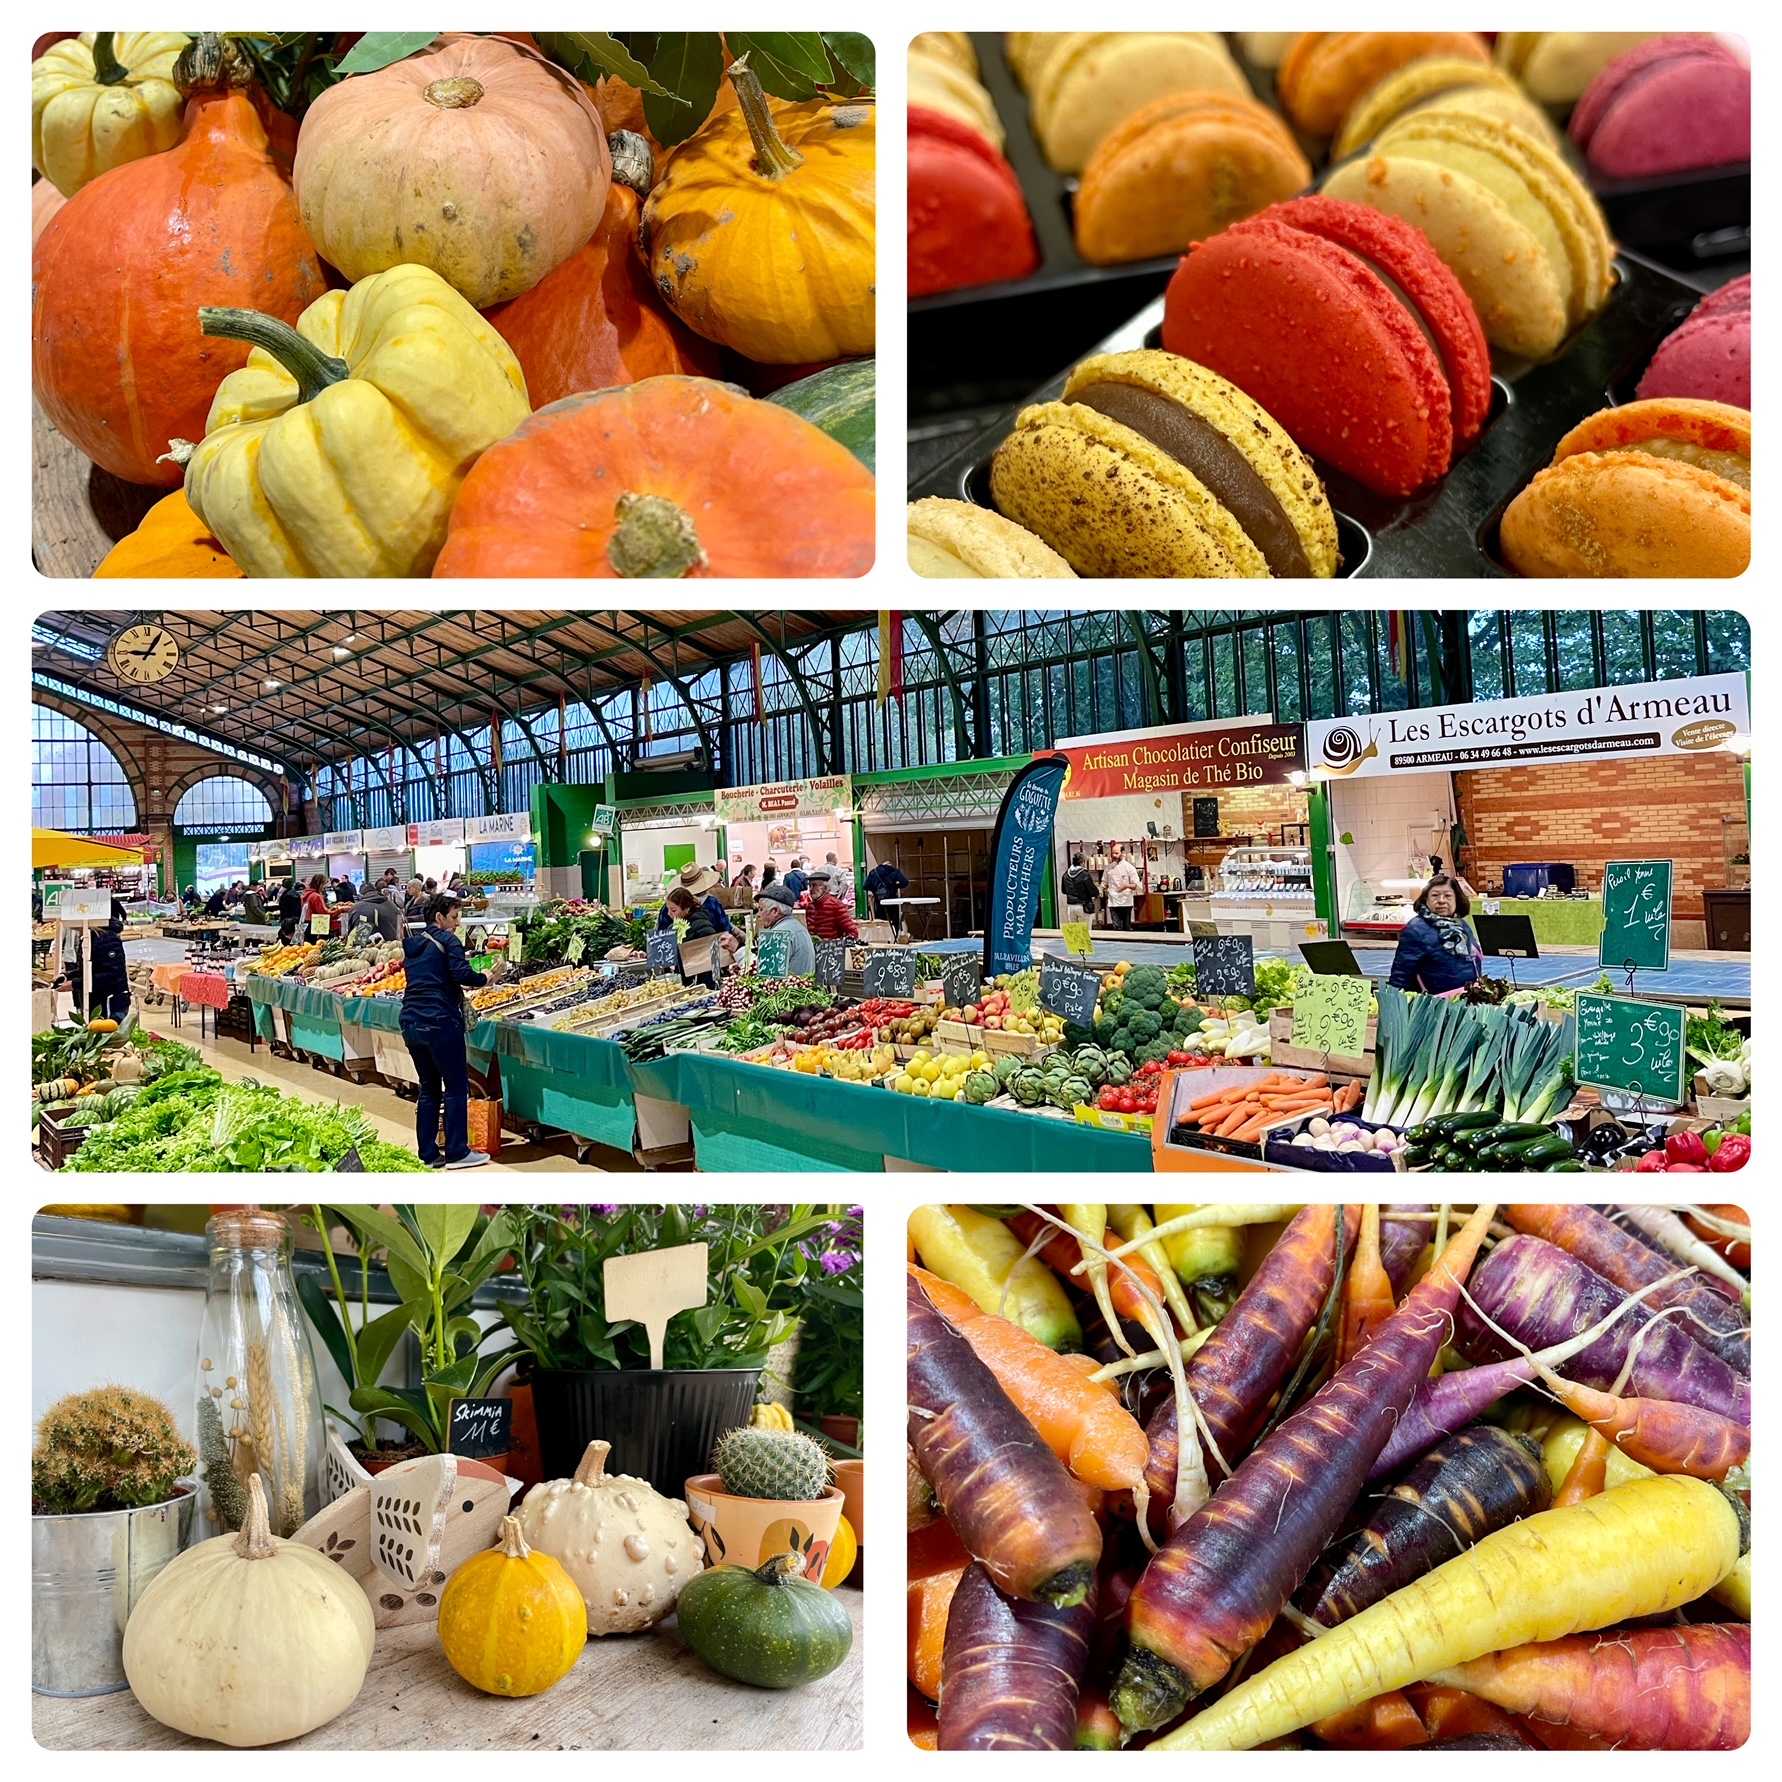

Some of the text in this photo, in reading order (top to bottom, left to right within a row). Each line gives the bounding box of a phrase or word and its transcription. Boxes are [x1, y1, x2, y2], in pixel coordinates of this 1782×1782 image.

[1388, 692, 1732, 744] Les Escargots d'Armeau
[1682, 722, 1726, 737] Vente directe
[1082, 733, 1297, 771] Artisan Chocolatier Confiseur
[1394, 755, 1415, 766] 89500
[1416, 752, 1453, 764] ARMEAU
[1460, 750, 1469, 760] 06
[1470, 749, 1479, 760] 34
[1481, 748, 1490, 759] 49
[1491, 748, 1501, 758] 66
[1502, 747, 1511, 757] 48
[1518, 737, 1655, 755] www.lesescargotsdarmeau.com
[1674, 737, 1695, 748] Visite
[1695, 735, 1704, 743] de
[721, 779, 844, 800] Boucherie Charcuterie Volailles
[1123, 761, 1264, 792] Magasin de Thé Bio
[781, 798, 796, 807] Pascal
[479, 820, 487, 834] LA
[489, 816, 514, 833] MARINE
[1003, 835, 1024, 940] PRODUCTEURS
[1016, 846, 1035, 936] MARAICHERS
